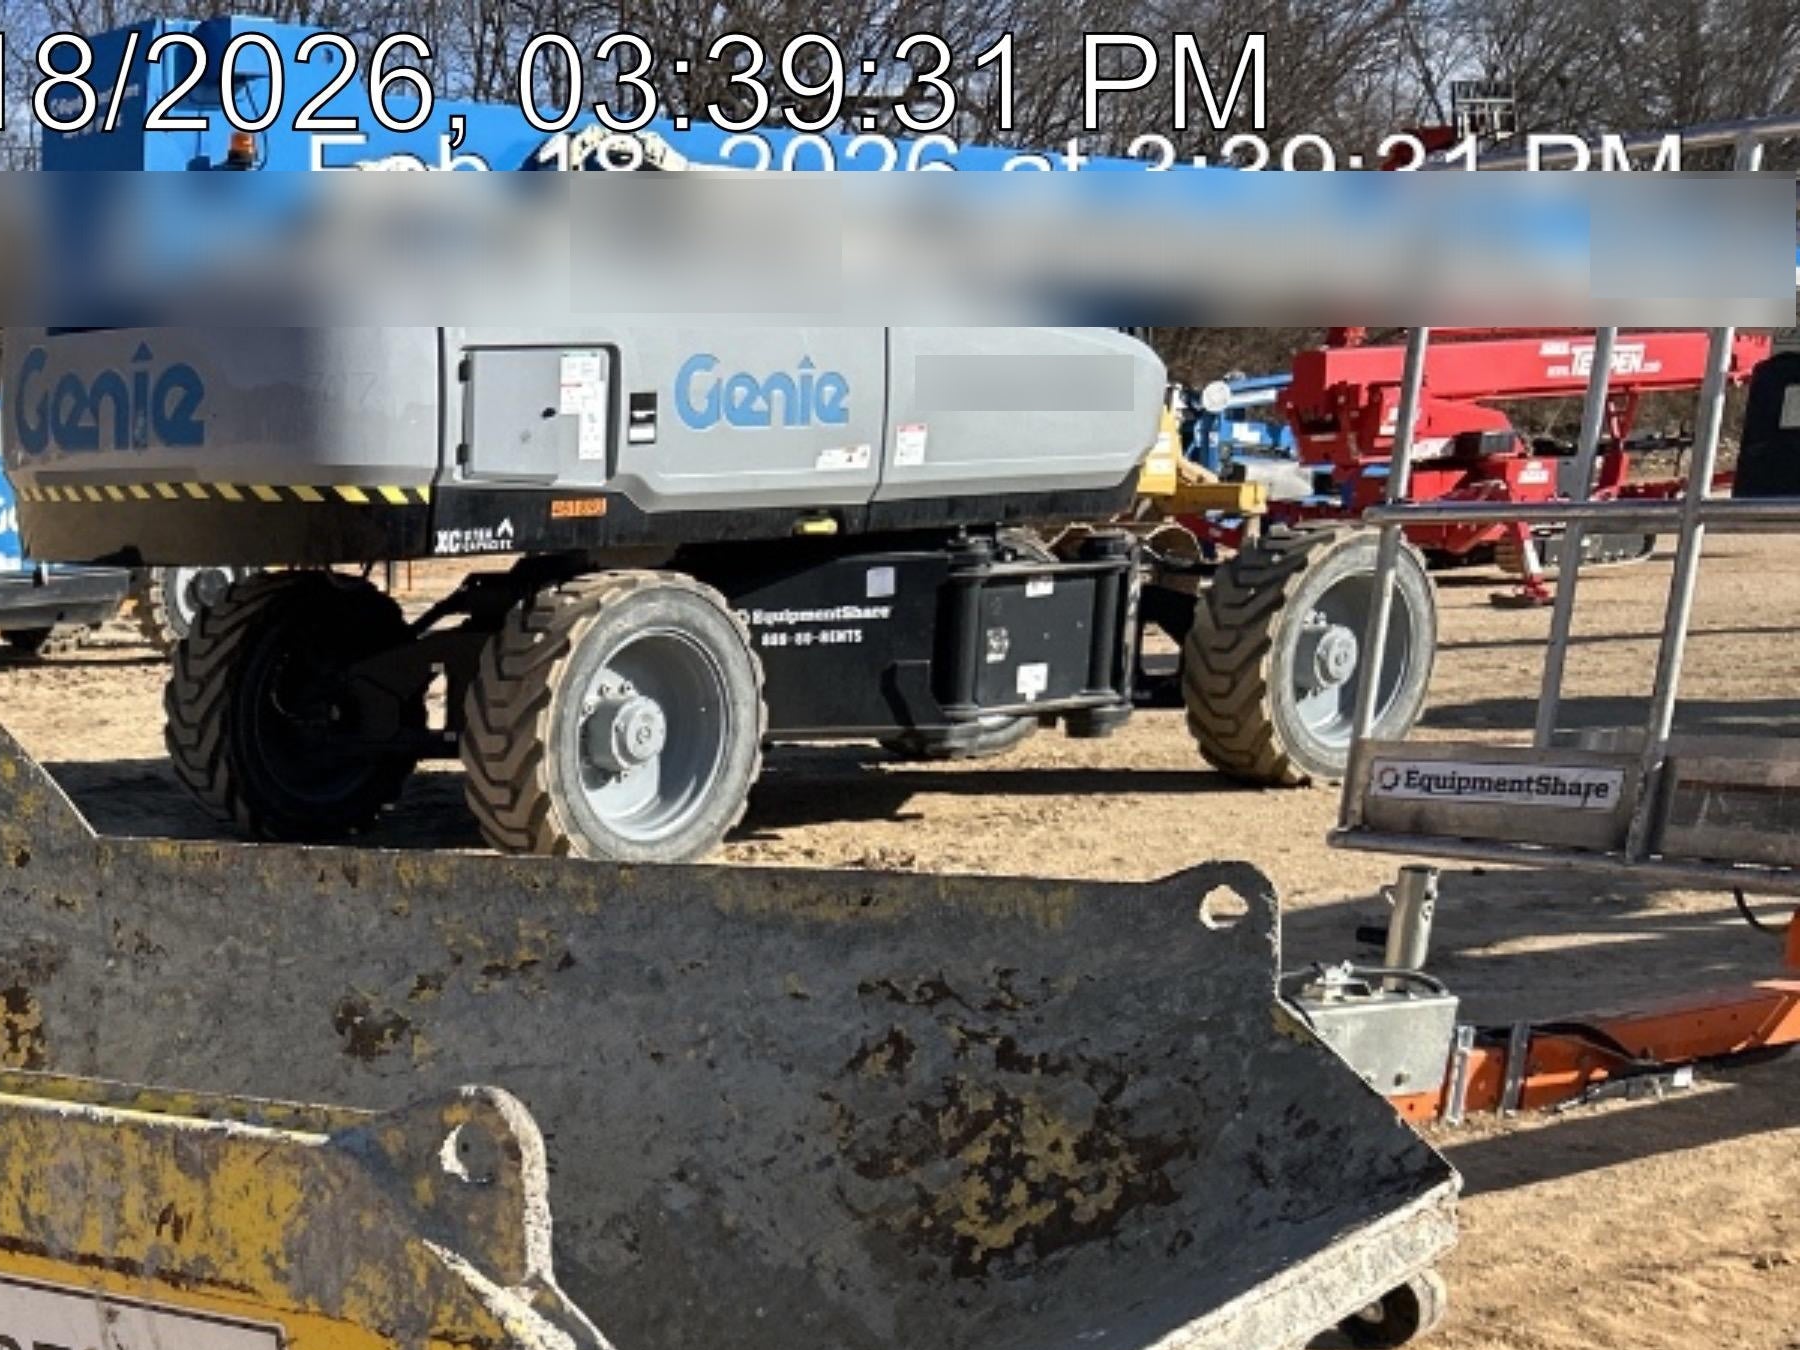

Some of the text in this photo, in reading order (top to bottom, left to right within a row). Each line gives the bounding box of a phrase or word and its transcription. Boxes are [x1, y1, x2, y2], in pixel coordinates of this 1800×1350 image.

[16, 340, 206, 454] Genie
[674, 353, 850, 431] Genie
[1404, 769, 1610, 799] EquipmentShare
